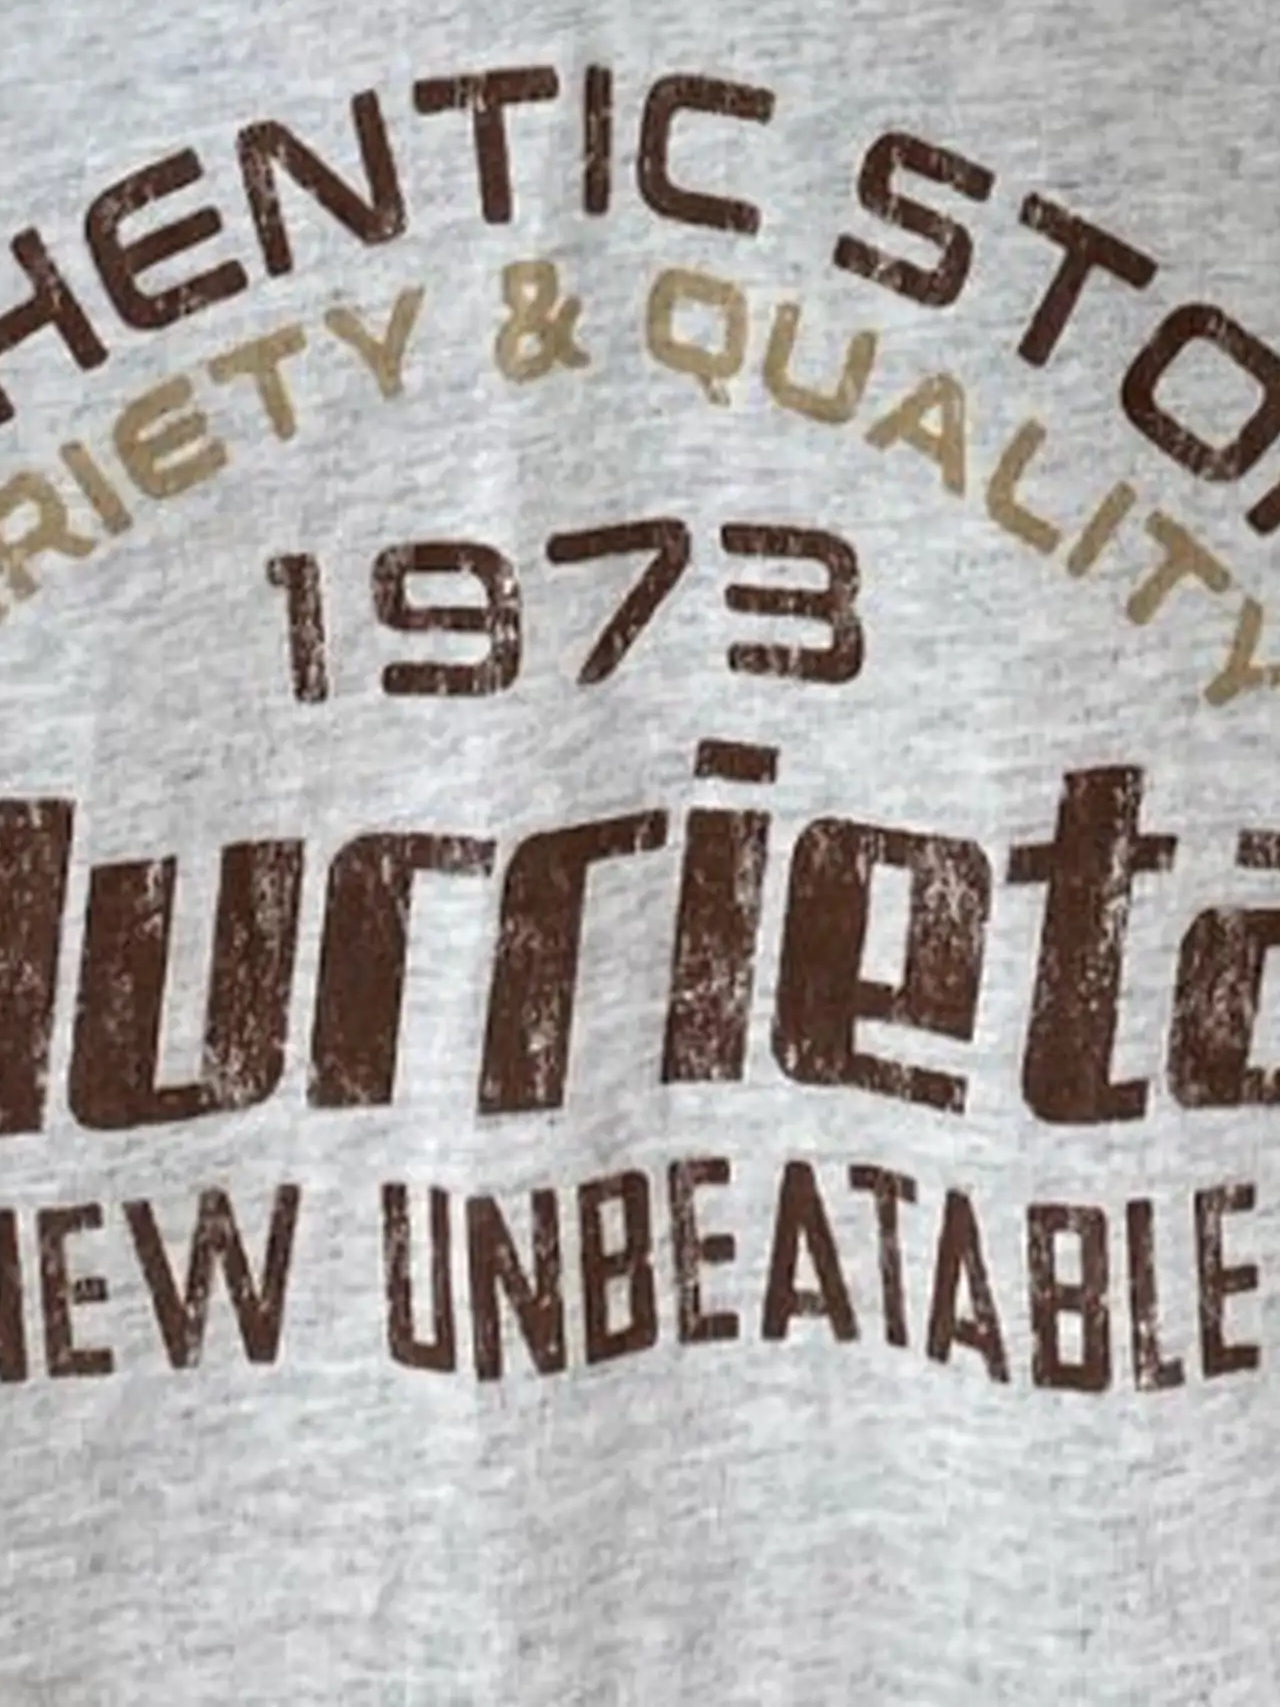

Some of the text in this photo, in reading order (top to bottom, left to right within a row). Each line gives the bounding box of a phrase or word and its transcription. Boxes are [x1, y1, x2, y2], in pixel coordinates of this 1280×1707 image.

[494, 260, 591, 382] &
[266, 517, 866, 704] 1973
[381, 1156, 1260, 1393] UNBEATABLE
